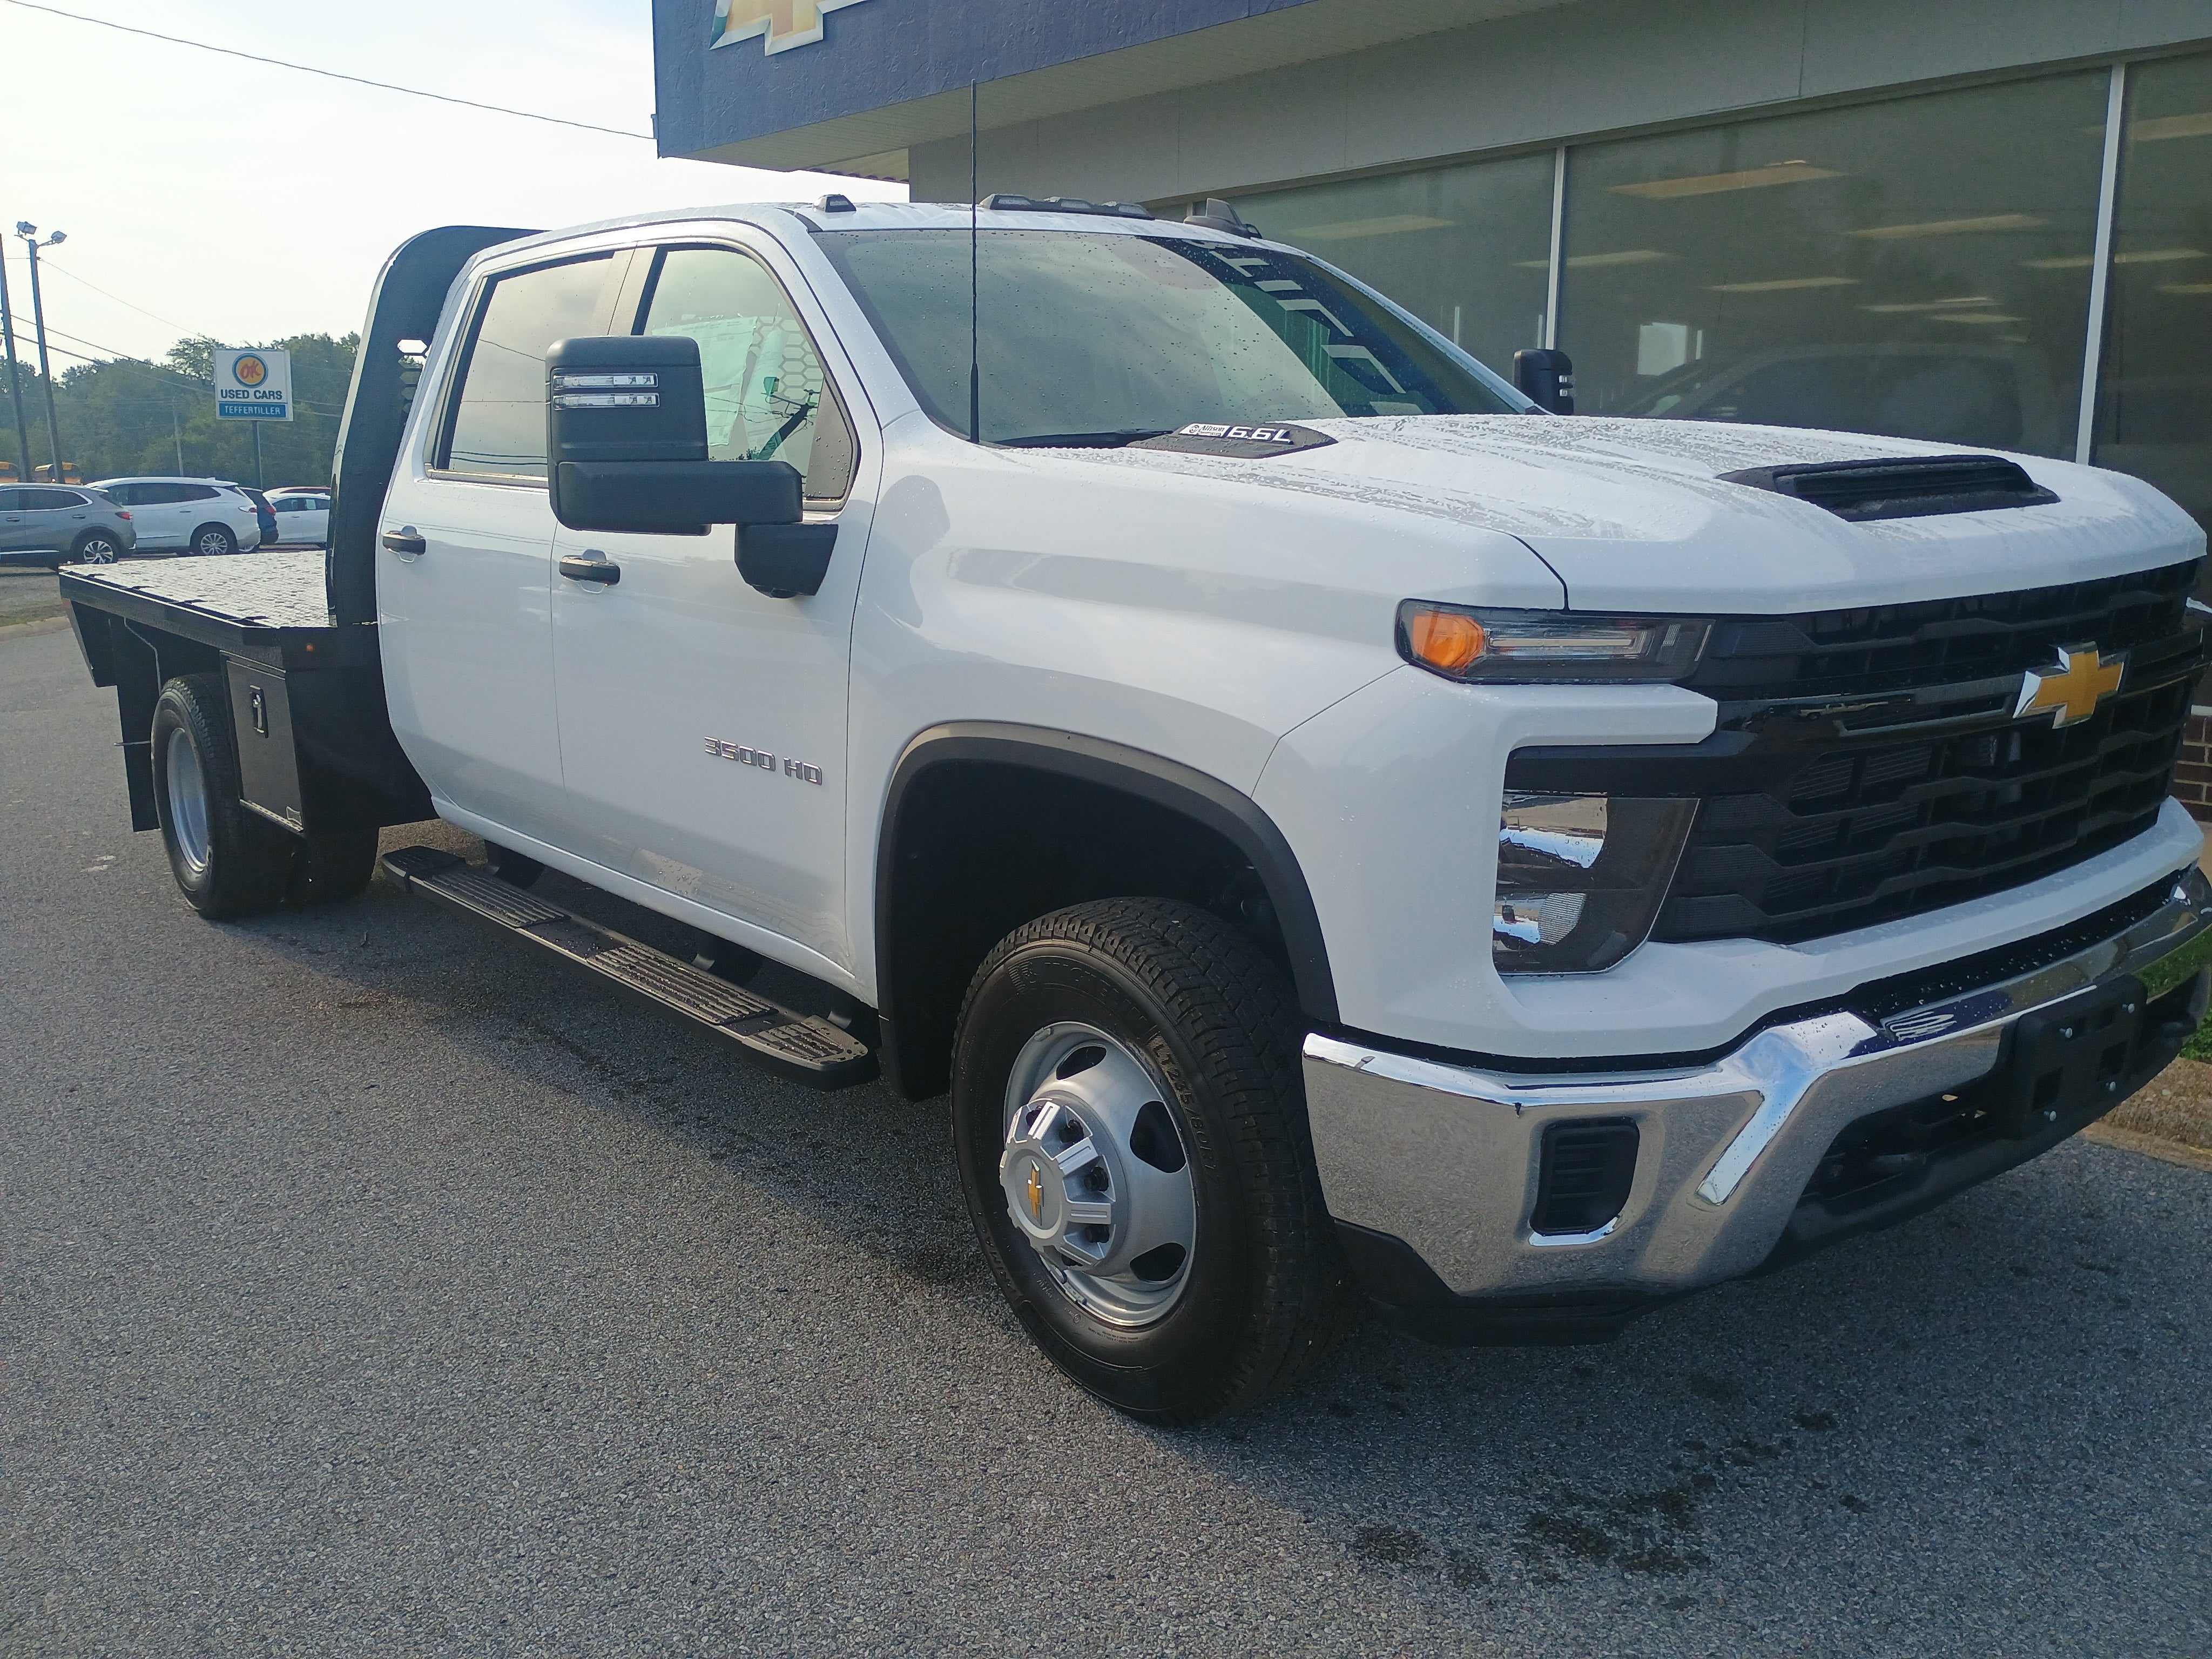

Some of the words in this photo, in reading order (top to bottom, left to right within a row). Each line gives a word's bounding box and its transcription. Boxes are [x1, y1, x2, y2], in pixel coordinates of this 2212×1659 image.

[240, 360, 261, 379] OK
[220, 389, 249, 399] USED
[253, 390, 282, 400] CARS
[225, 406, 280, 415] TEFFERTILLER
[1227, 426, 1293, 444] 6.6L
[704, 735, 776, 772] 3500
[784, 756, 822, 786] HD
